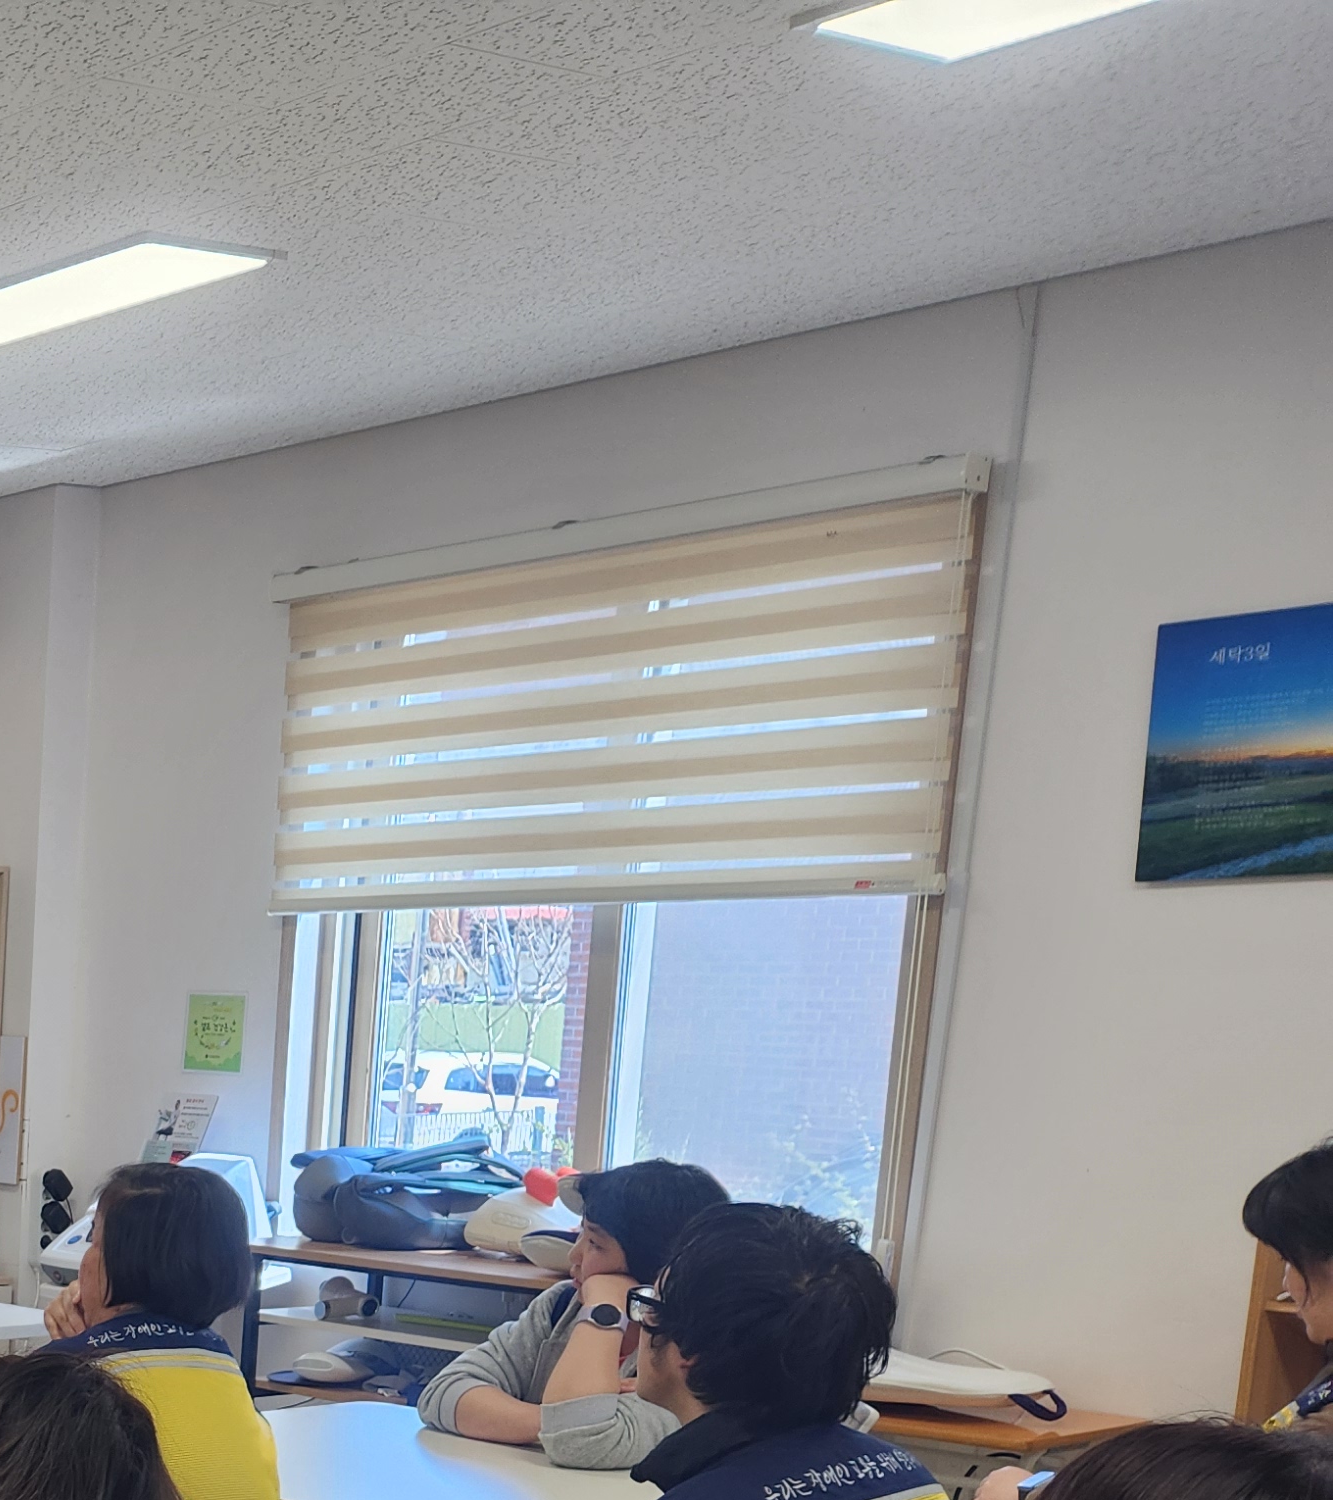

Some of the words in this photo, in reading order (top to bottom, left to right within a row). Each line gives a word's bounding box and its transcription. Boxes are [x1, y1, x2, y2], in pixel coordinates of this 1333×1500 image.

[86, 1329, 126, 1348] 우리는
[124, 1322, 165, 1337] 장애인
[803, 1462, 855, 1494] 장애인
